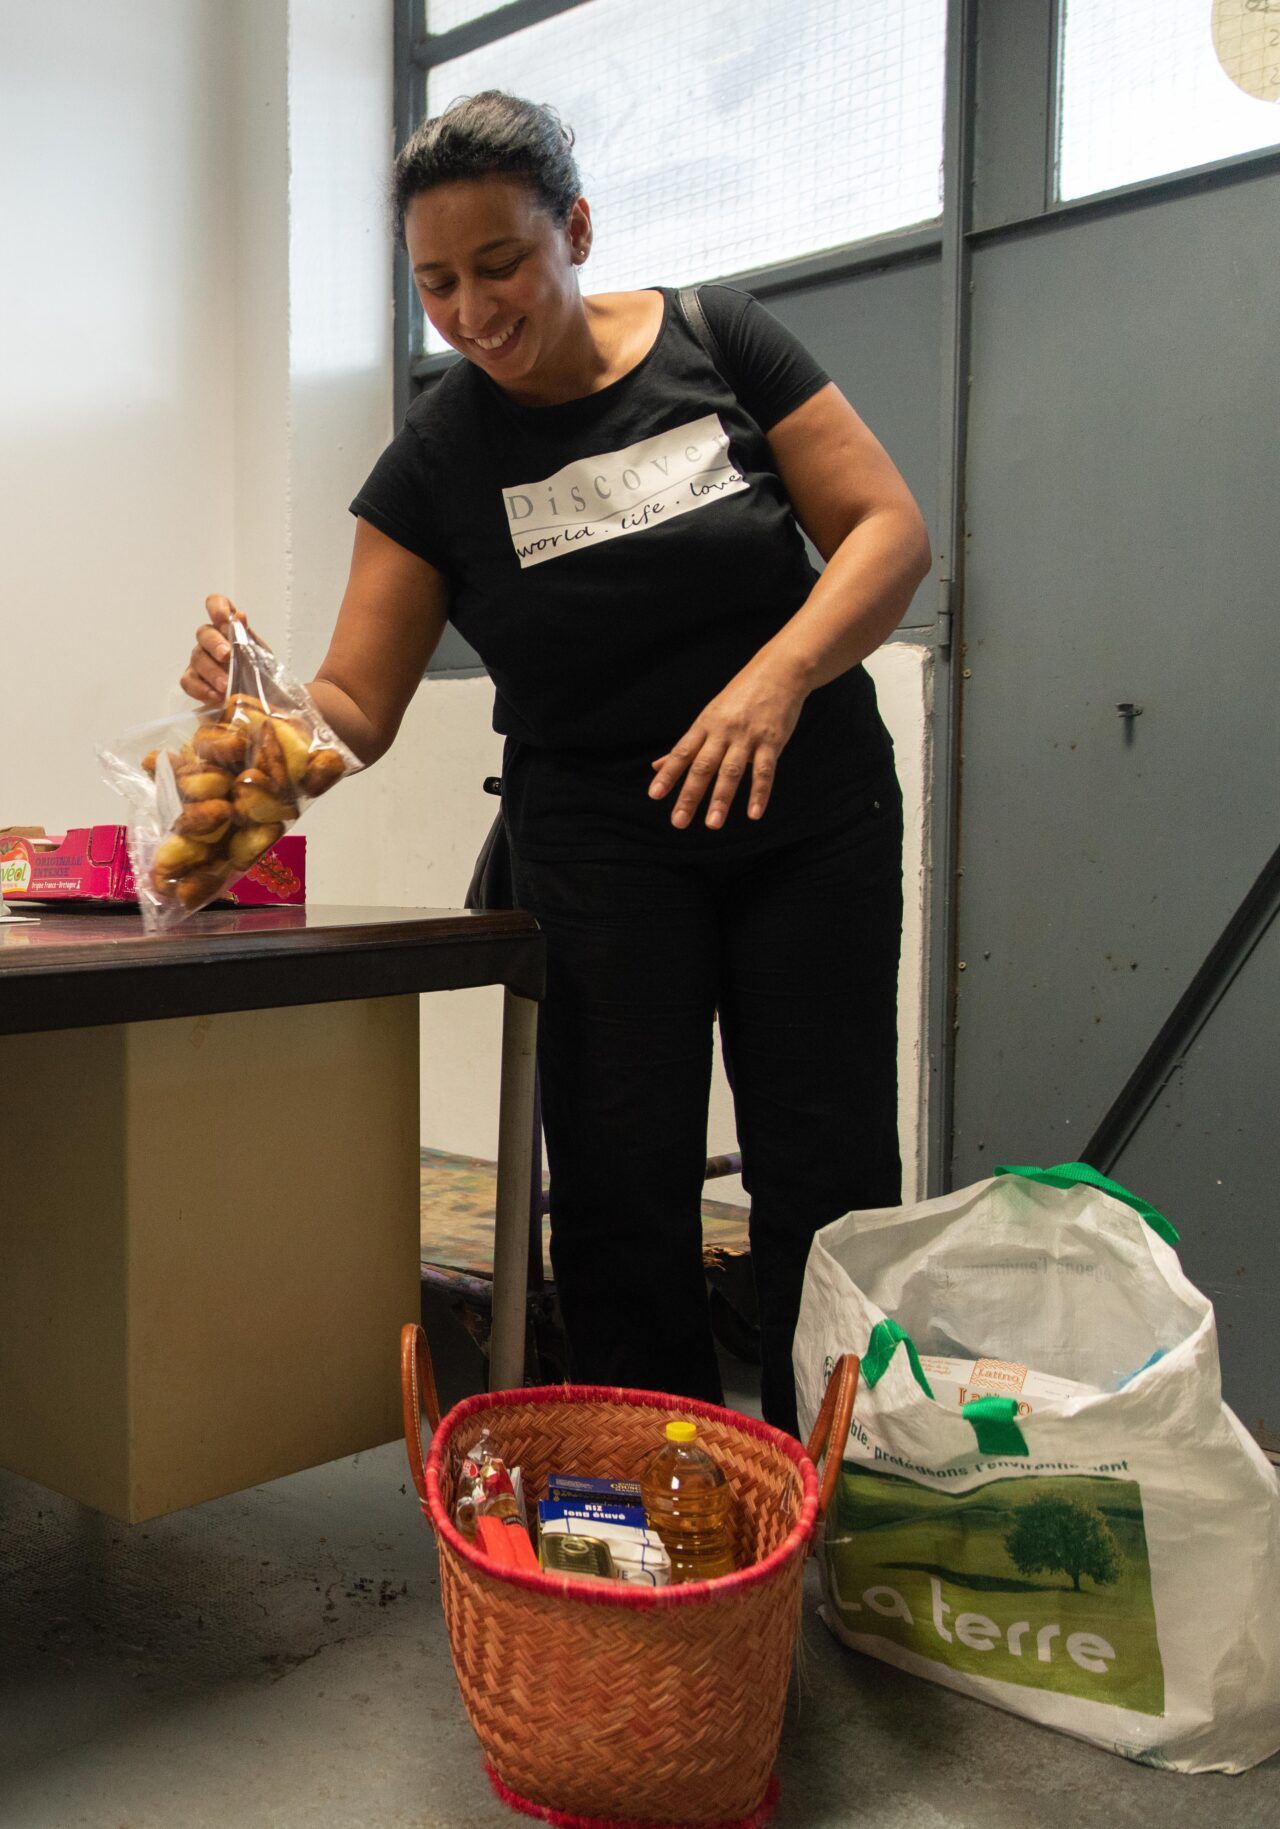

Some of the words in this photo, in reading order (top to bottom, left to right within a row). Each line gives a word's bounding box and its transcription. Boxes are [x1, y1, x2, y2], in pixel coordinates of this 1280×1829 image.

[517, 527, 595, 558] world
[621, 502, 665, 530] life
[689, 474, 742, 497] love
[0, 863, 27, 881] véol
[977, 1369, 1019, 1384] Latino
[830, 1561, 915, 1626] La
[930, 1576, 1117, 1674] terre
